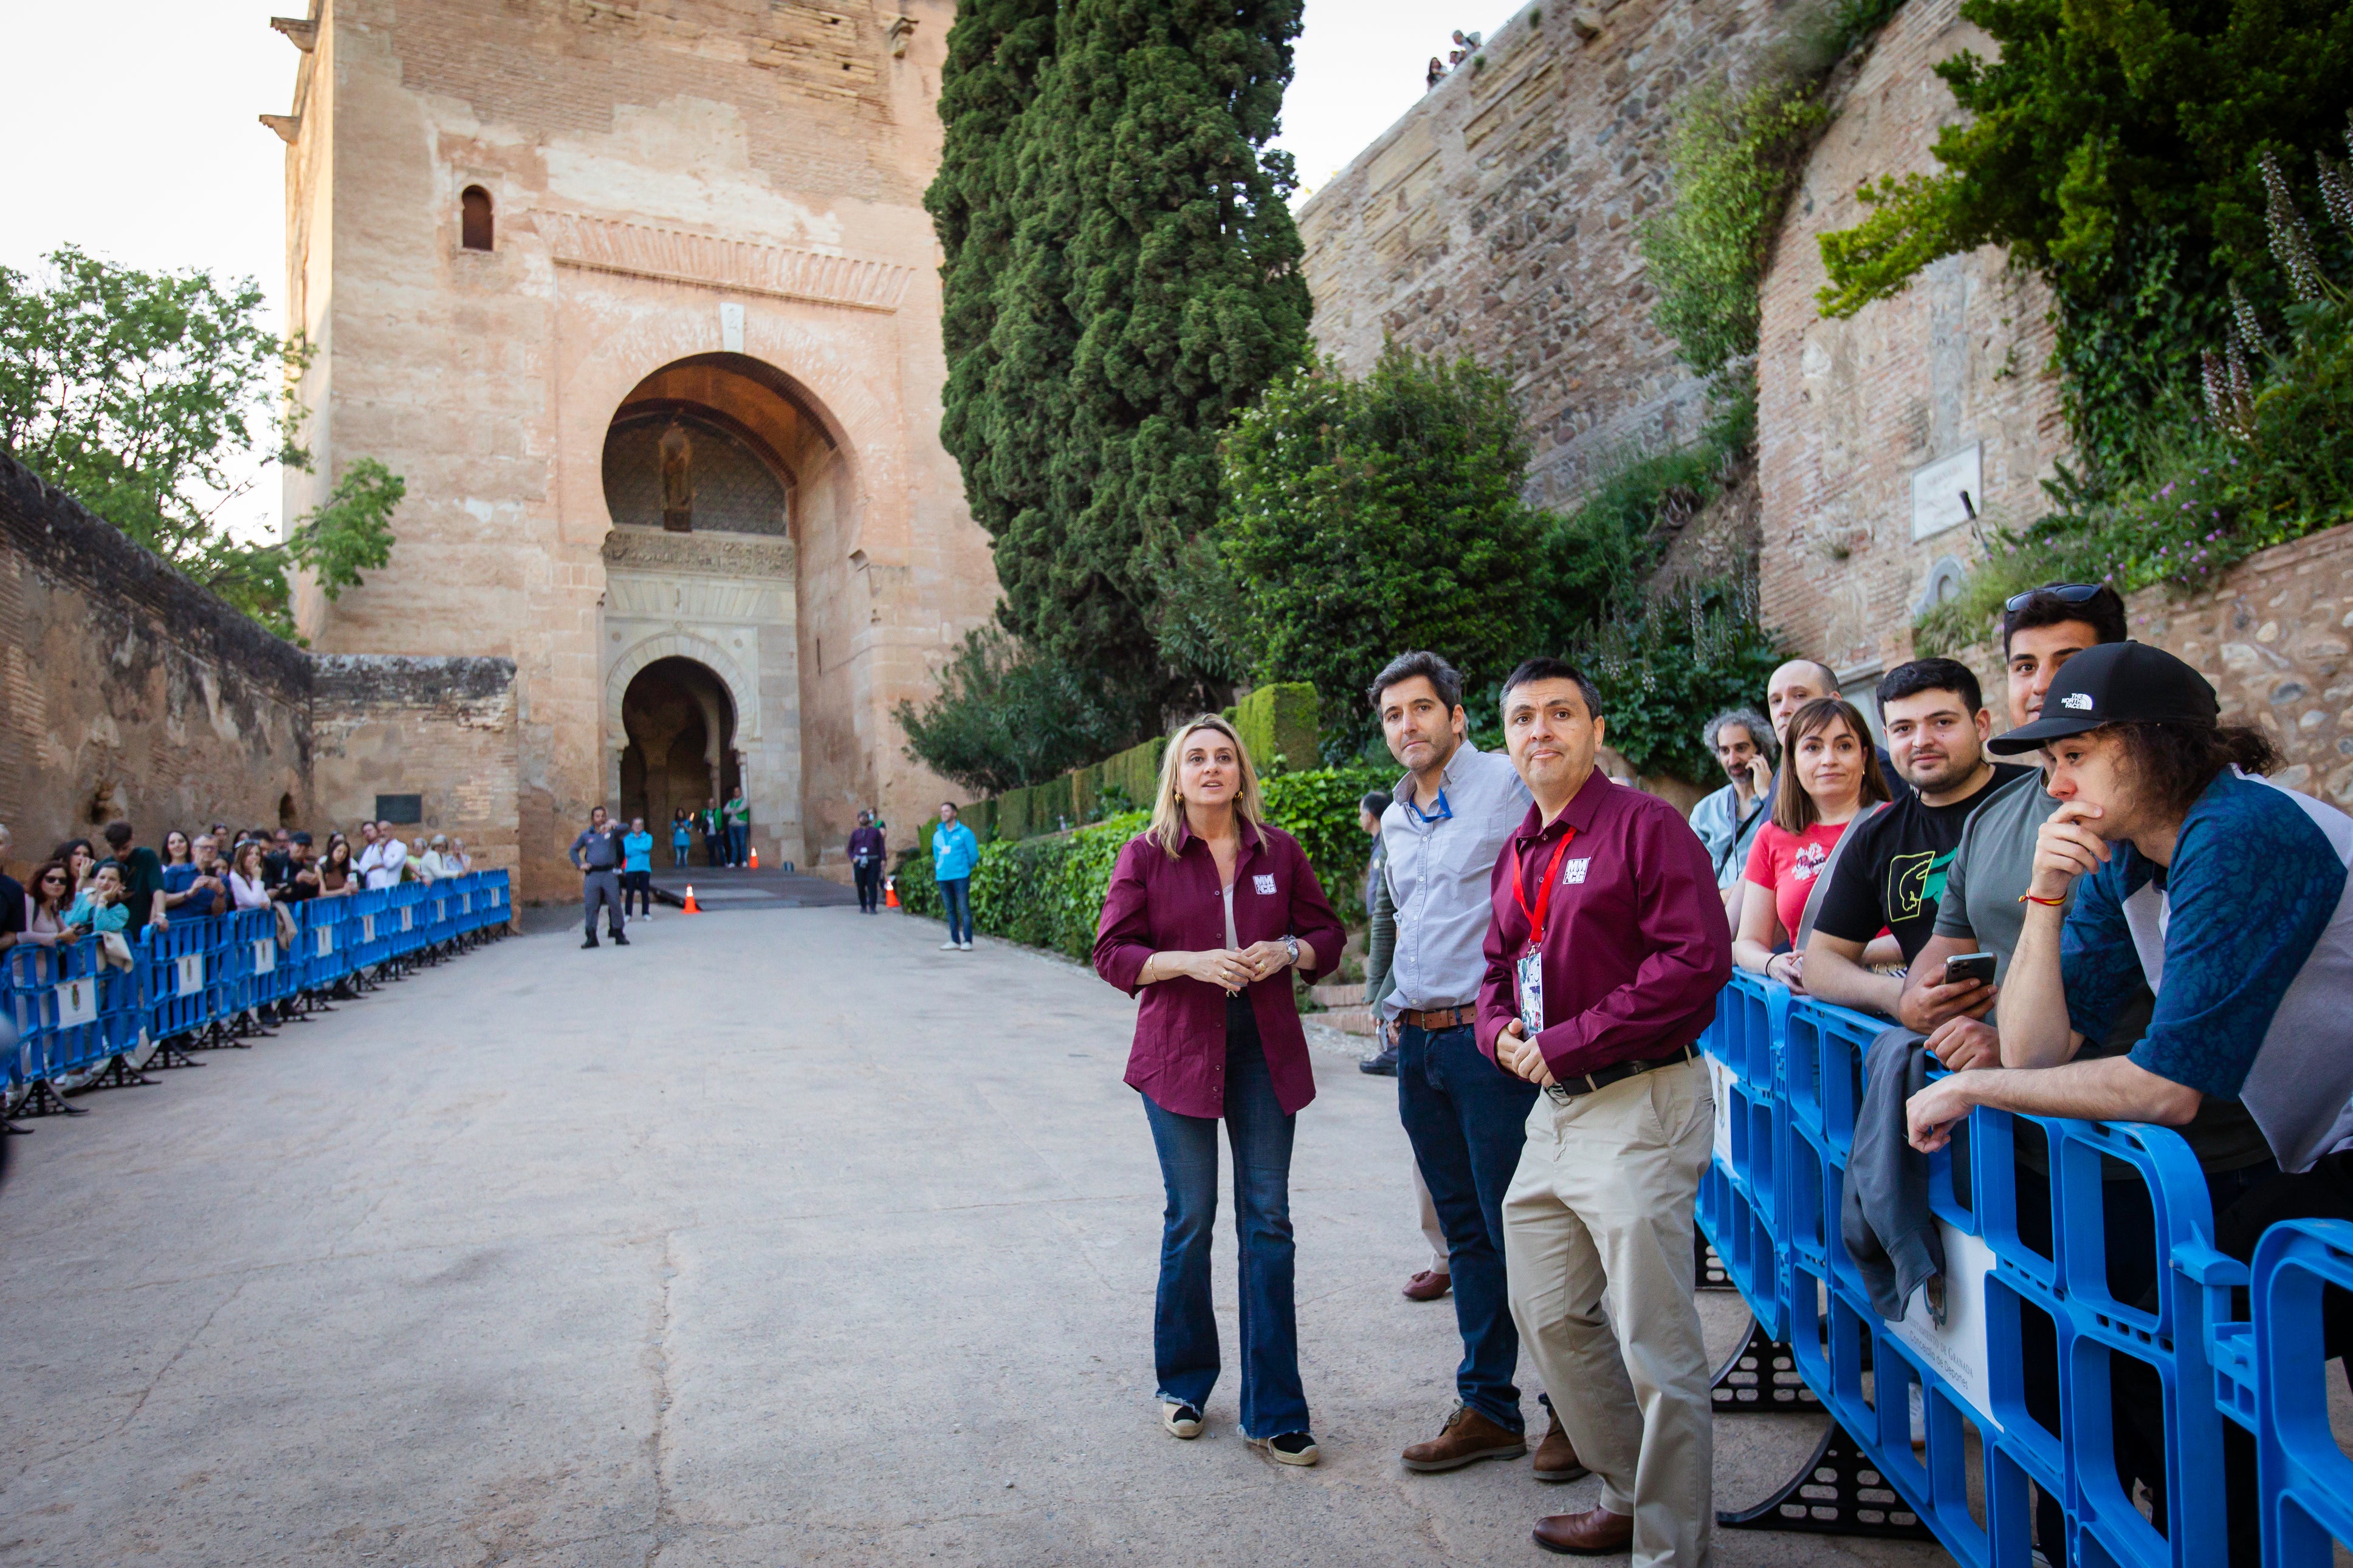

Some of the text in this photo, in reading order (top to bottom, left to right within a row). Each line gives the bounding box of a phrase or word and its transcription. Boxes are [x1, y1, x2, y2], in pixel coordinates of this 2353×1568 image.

[1567, 860, 1588, 872] MM
[1254, 875, 1274, 885] MM
[1568, 871, 1585, 883] CG
[1940, 1343, 1947, 1355] DE
[1948, 1347, 1973, 1378] GRANADA
[1936, 1355, 1943, 1368] de
[1945, 1360, 1968, 1390] Deportes
